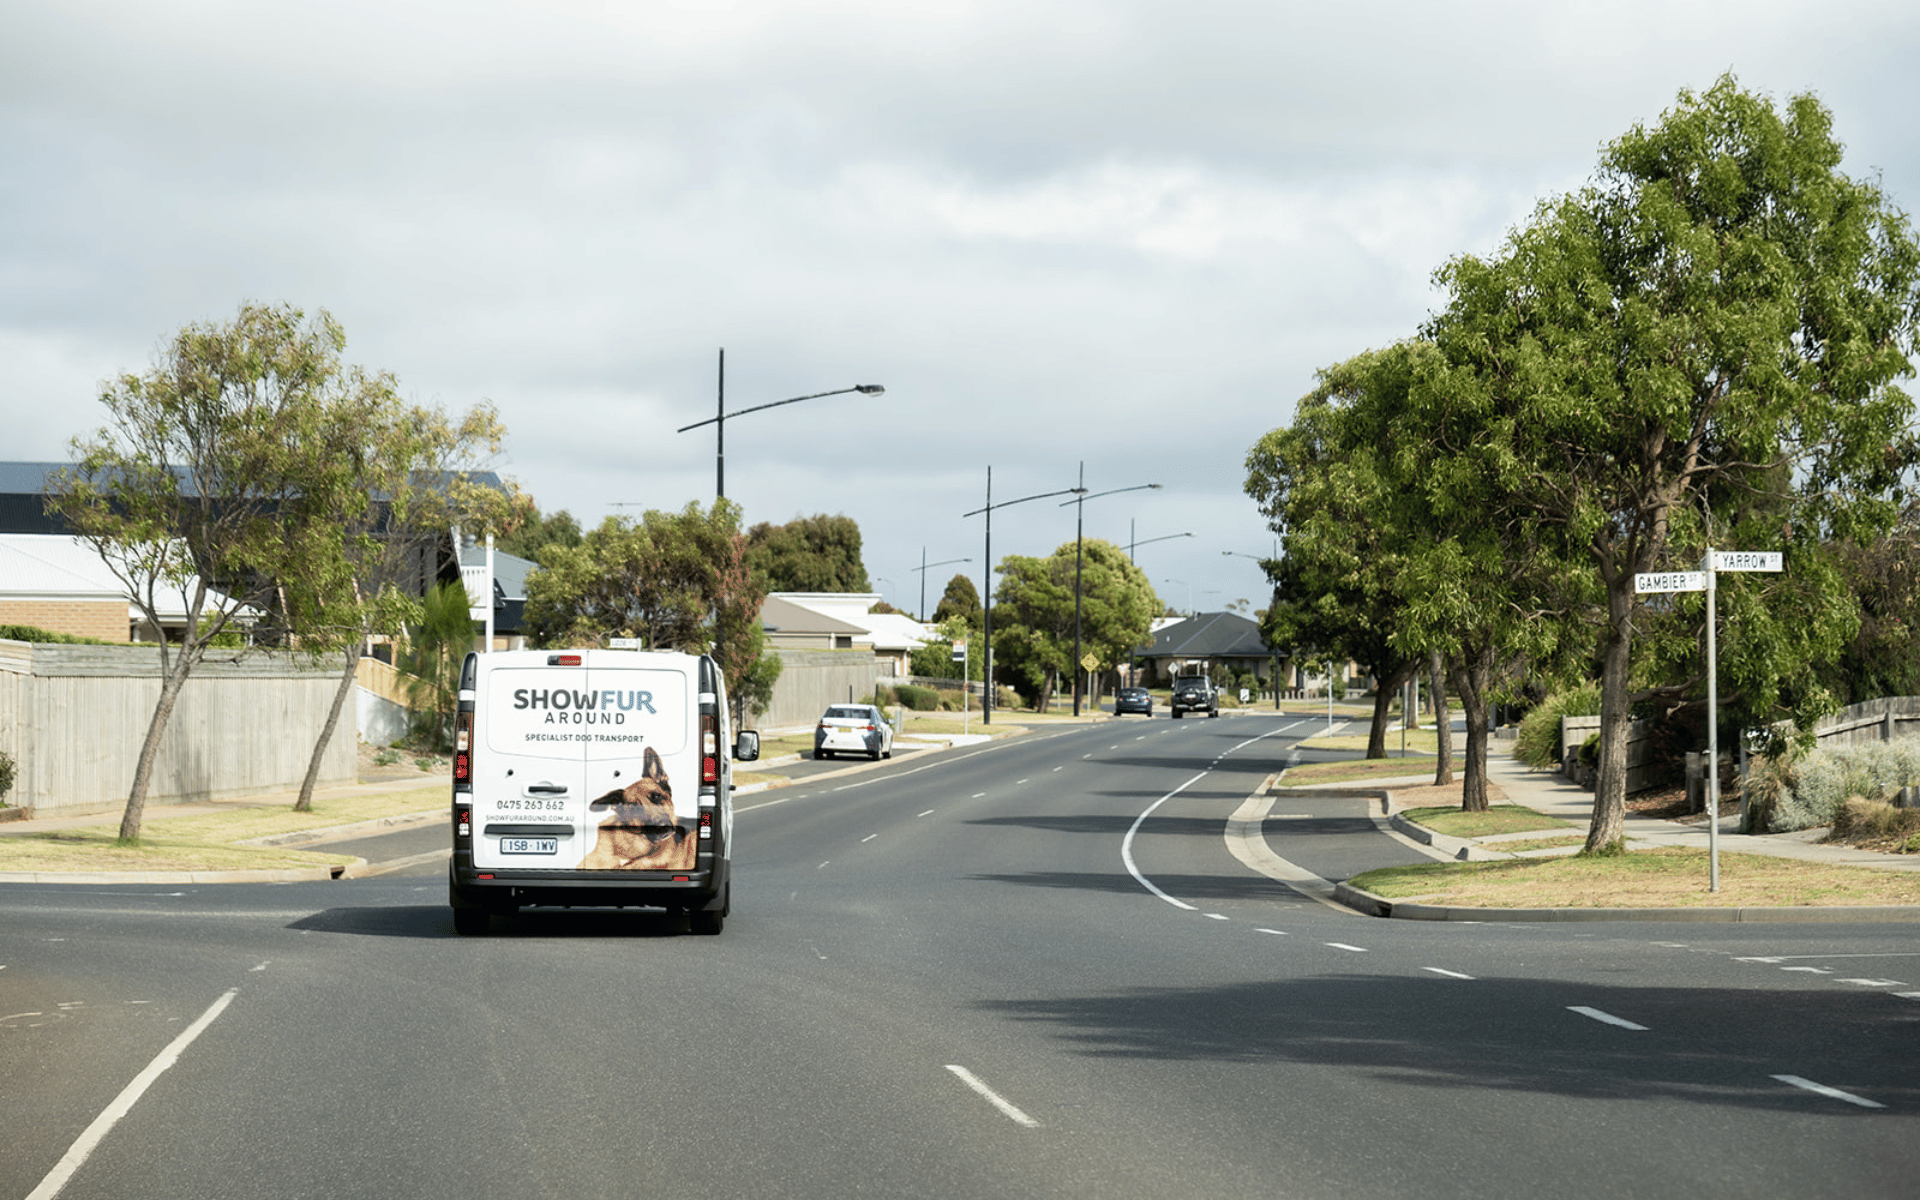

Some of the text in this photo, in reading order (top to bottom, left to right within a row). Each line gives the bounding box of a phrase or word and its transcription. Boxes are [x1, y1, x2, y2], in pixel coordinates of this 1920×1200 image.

[1722, 554, 1779, 569] YARROW ST
[1638, 574, 1698, 590] GAMBIER ST
[513, 688, 657, 715] SHOWFUR
[544, 711, 625, 725] AROUND
[525, 733, 644, 743] SPECIALIST DOG TRANSPORT
[497, 800, 565, 811] 0475 263 662
